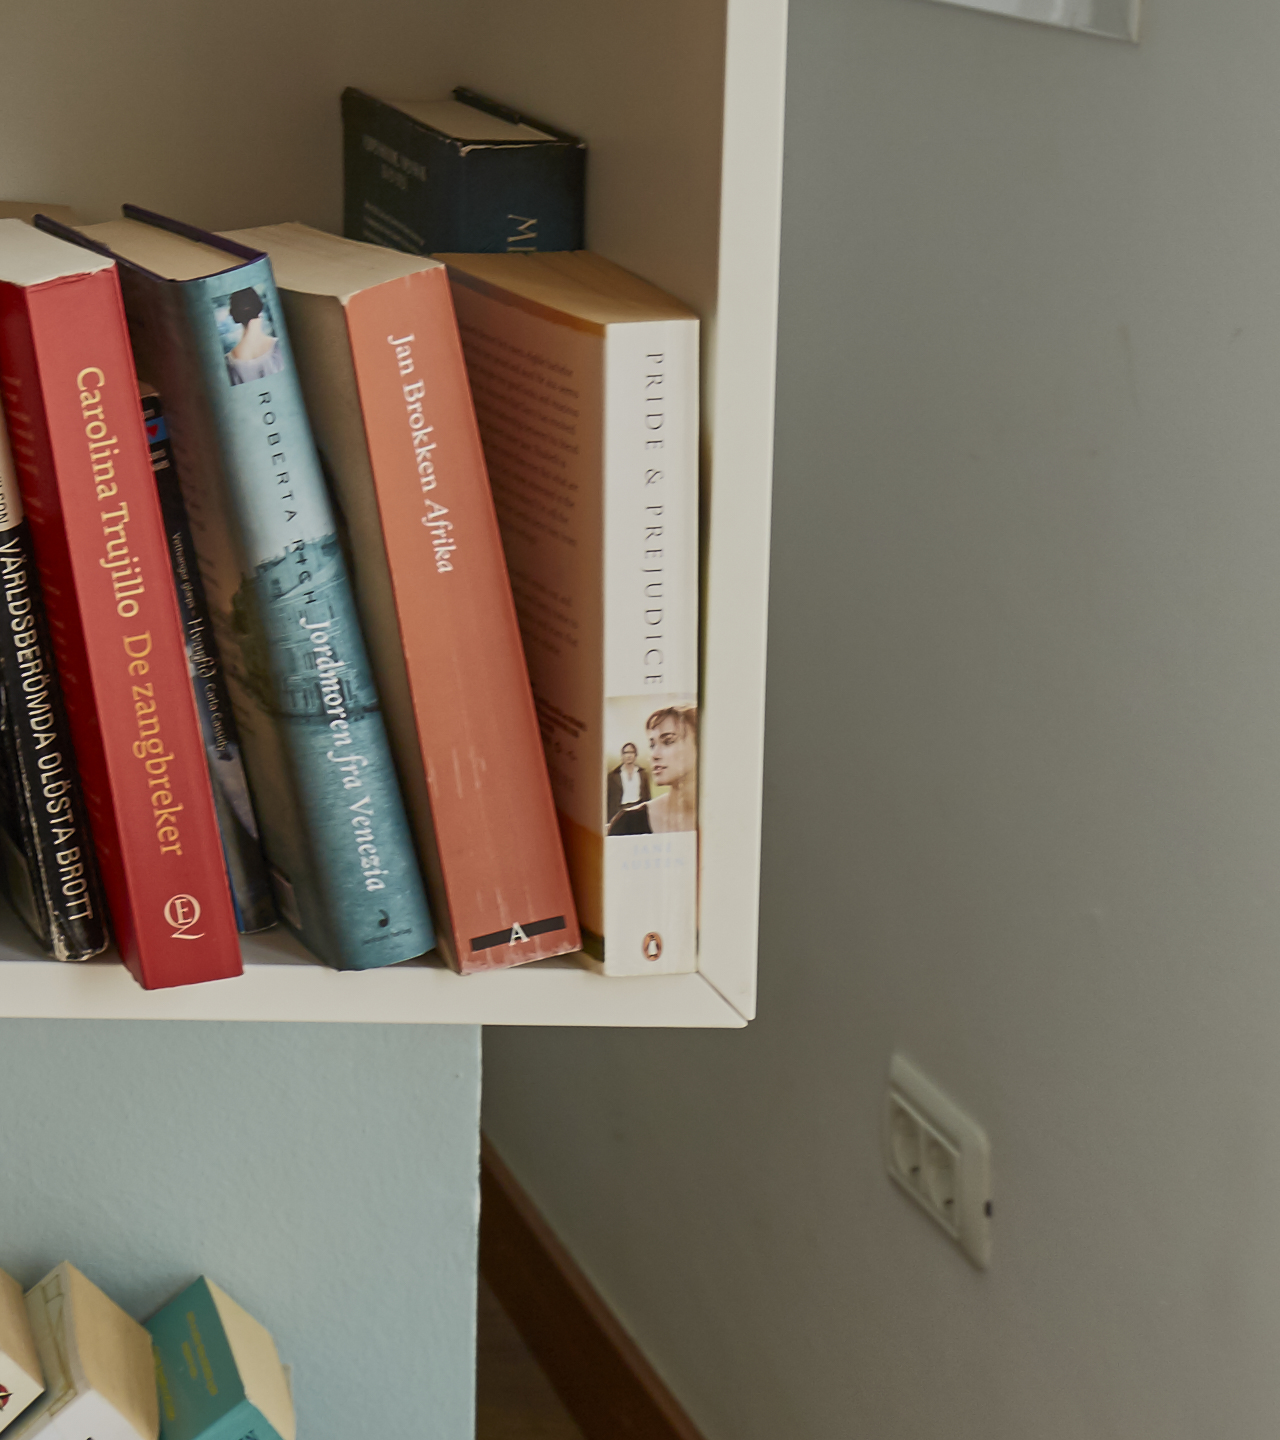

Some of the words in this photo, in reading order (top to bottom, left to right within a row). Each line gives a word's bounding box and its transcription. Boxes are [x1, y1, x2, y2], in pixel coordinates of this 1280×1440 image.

[387, 332, 419, 375] Jan
[644, 351, 666, 451] PRIDE
[75, 365, 117, 500] Carolina
[402, 381, 439, 494] Brokken
[645, 467, 664, 486] &
[99, 501, 141, 620] Trujillo
[423, 497, 454, 576] Afrika
[642, 503, 665, 688] PREJUDICE
[122, 634, 152, 675] De
[299, 614, 350, 748] Jordmoren
[127, 675, 184, 858] zangbreker
[327, 750, 365, 793] fra
[345, 795, 385, 894] Venezia
